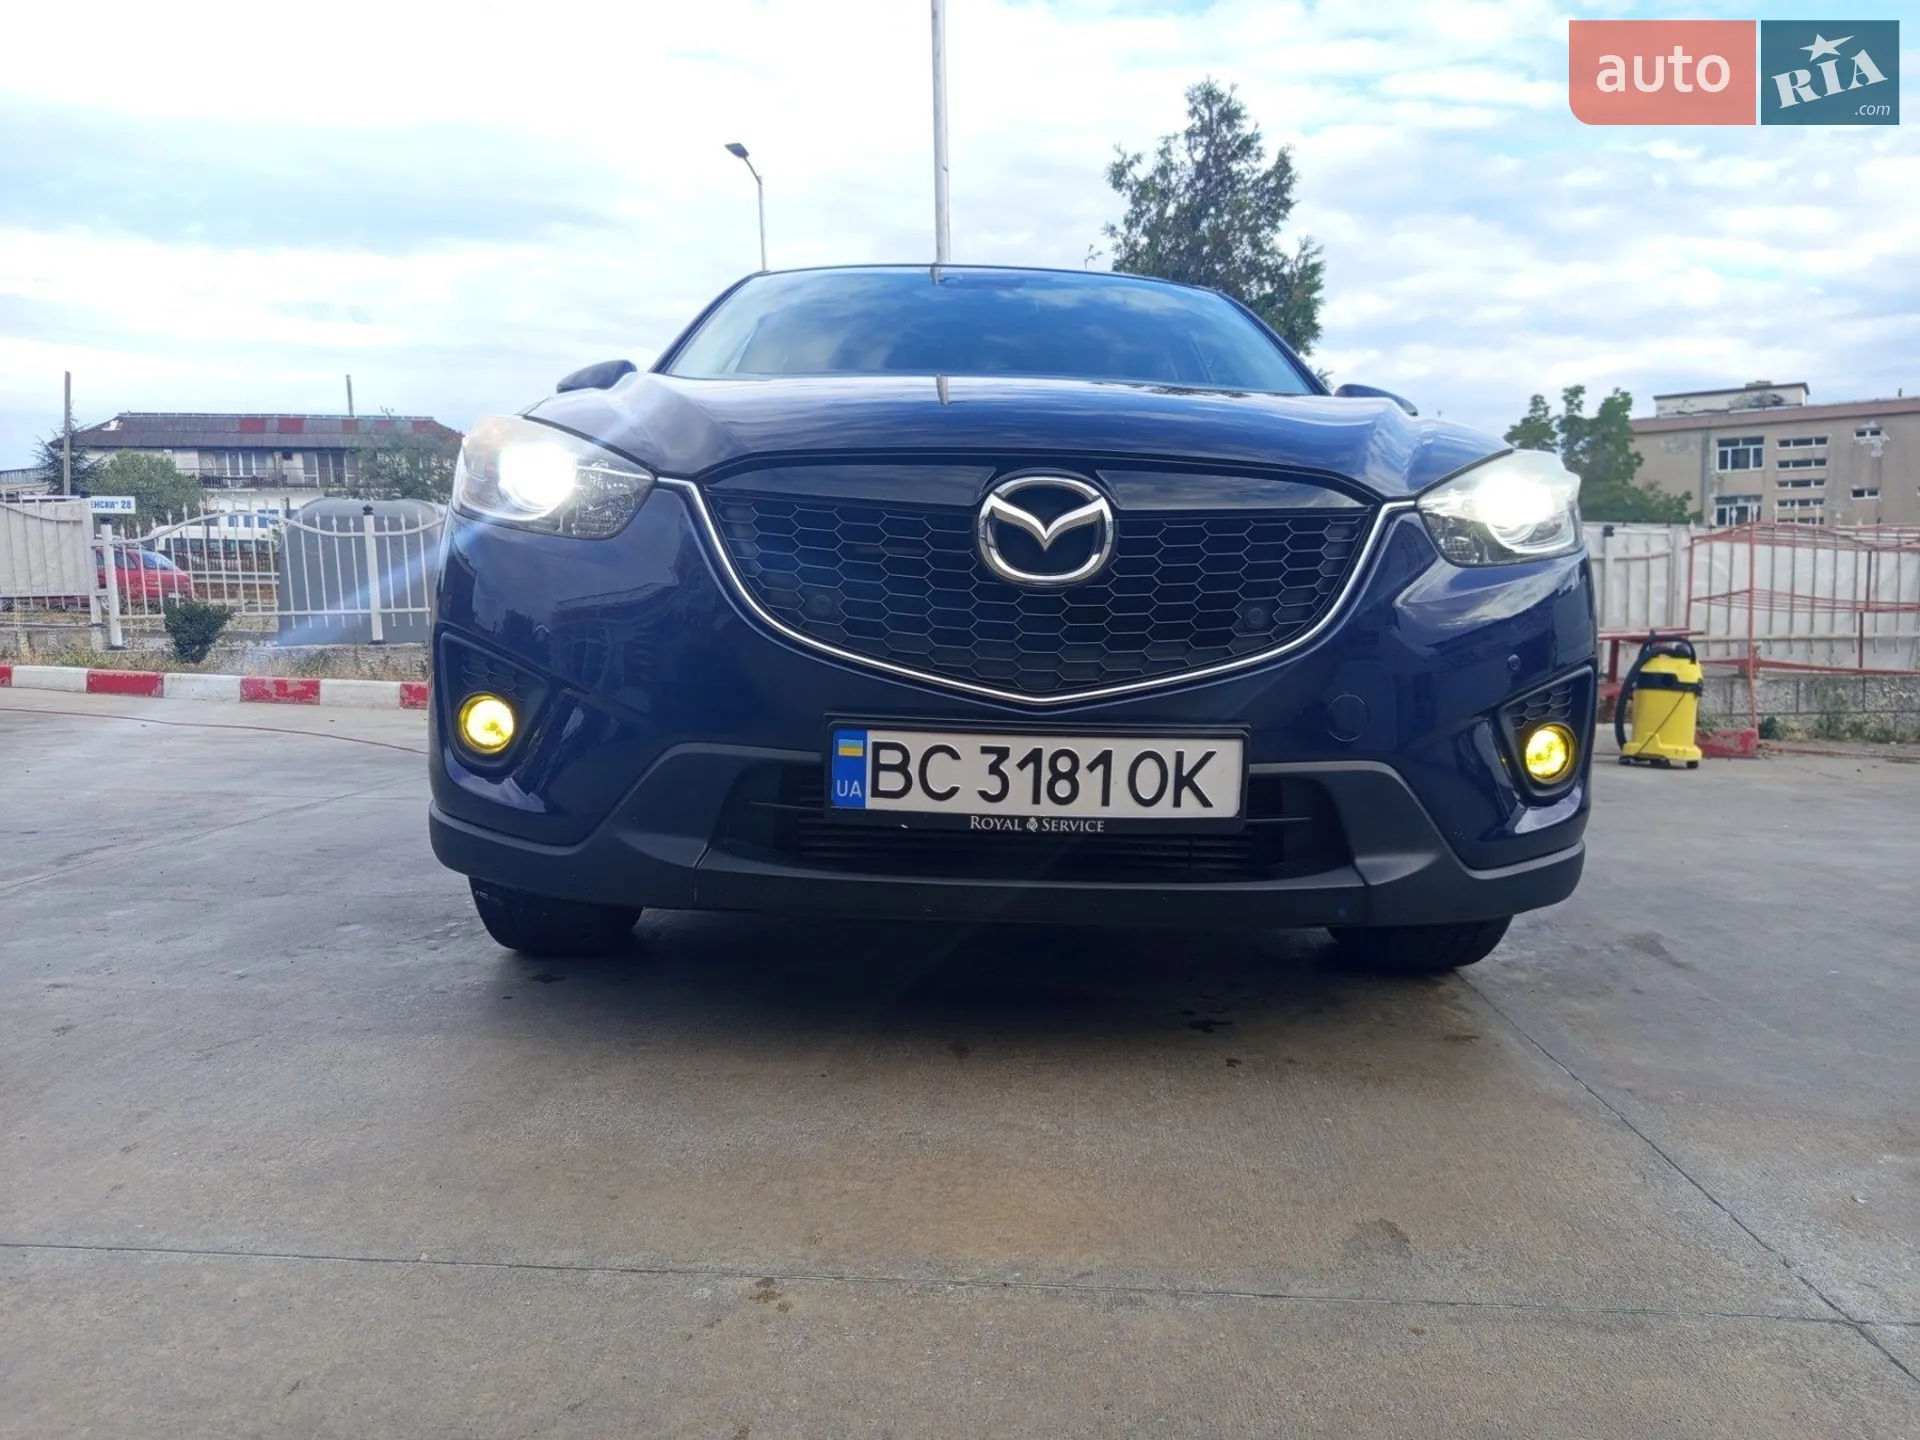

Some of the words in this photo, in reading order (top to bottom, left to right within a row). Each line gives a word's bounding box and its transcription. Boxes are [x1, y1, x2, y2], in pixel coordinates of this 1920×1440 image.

[121, 500, 132, 509] 28
[870, 741, 962, 801] BC
[976, 745, 1113, 808] 3181
[1127, 750, 1217, 809] OK
[836, 779, 863, 798] UA
[970, 815, 1022, 831] ROYAL
[1041, 817, 1105, 833] SERVICE
